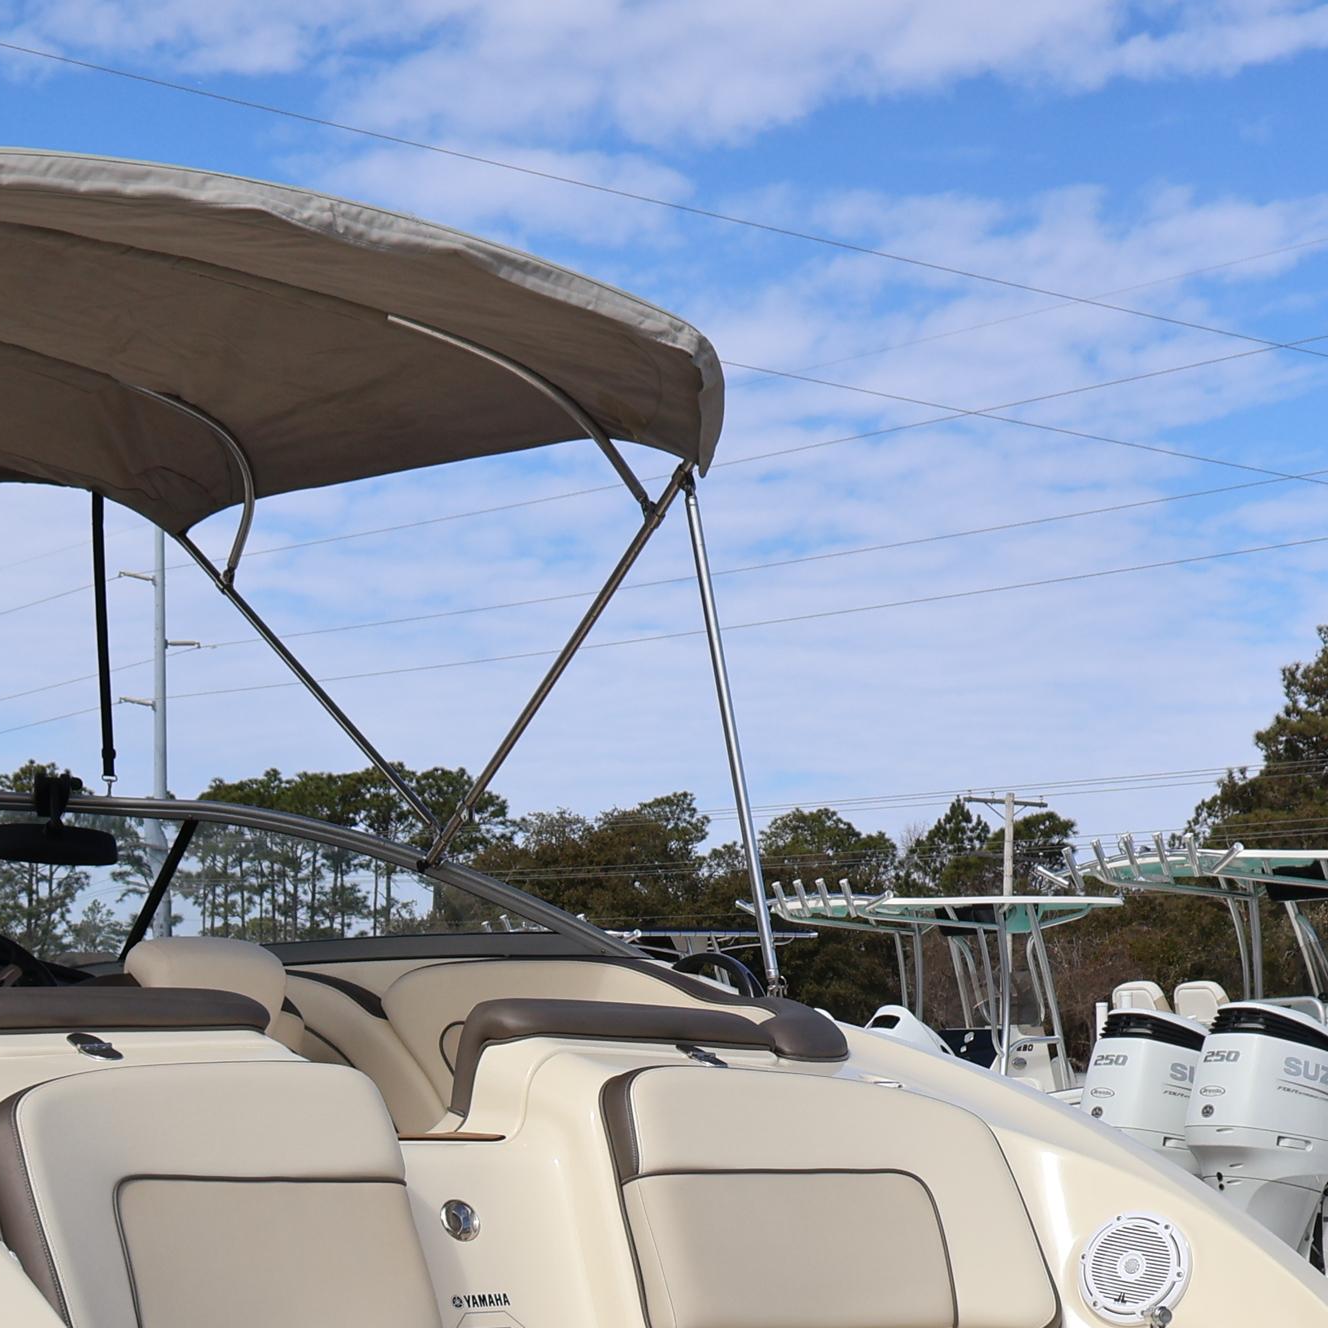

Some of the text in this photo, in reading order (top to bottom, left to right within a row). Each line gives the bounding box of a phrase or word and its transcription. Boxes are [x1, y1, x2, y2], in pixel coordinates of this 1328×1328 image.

[1094, 1054, 1128, 1066] 250
[1203, 1050, 1240, 1062] 250
[463, 1293, 511, 1308] YAMAHA
